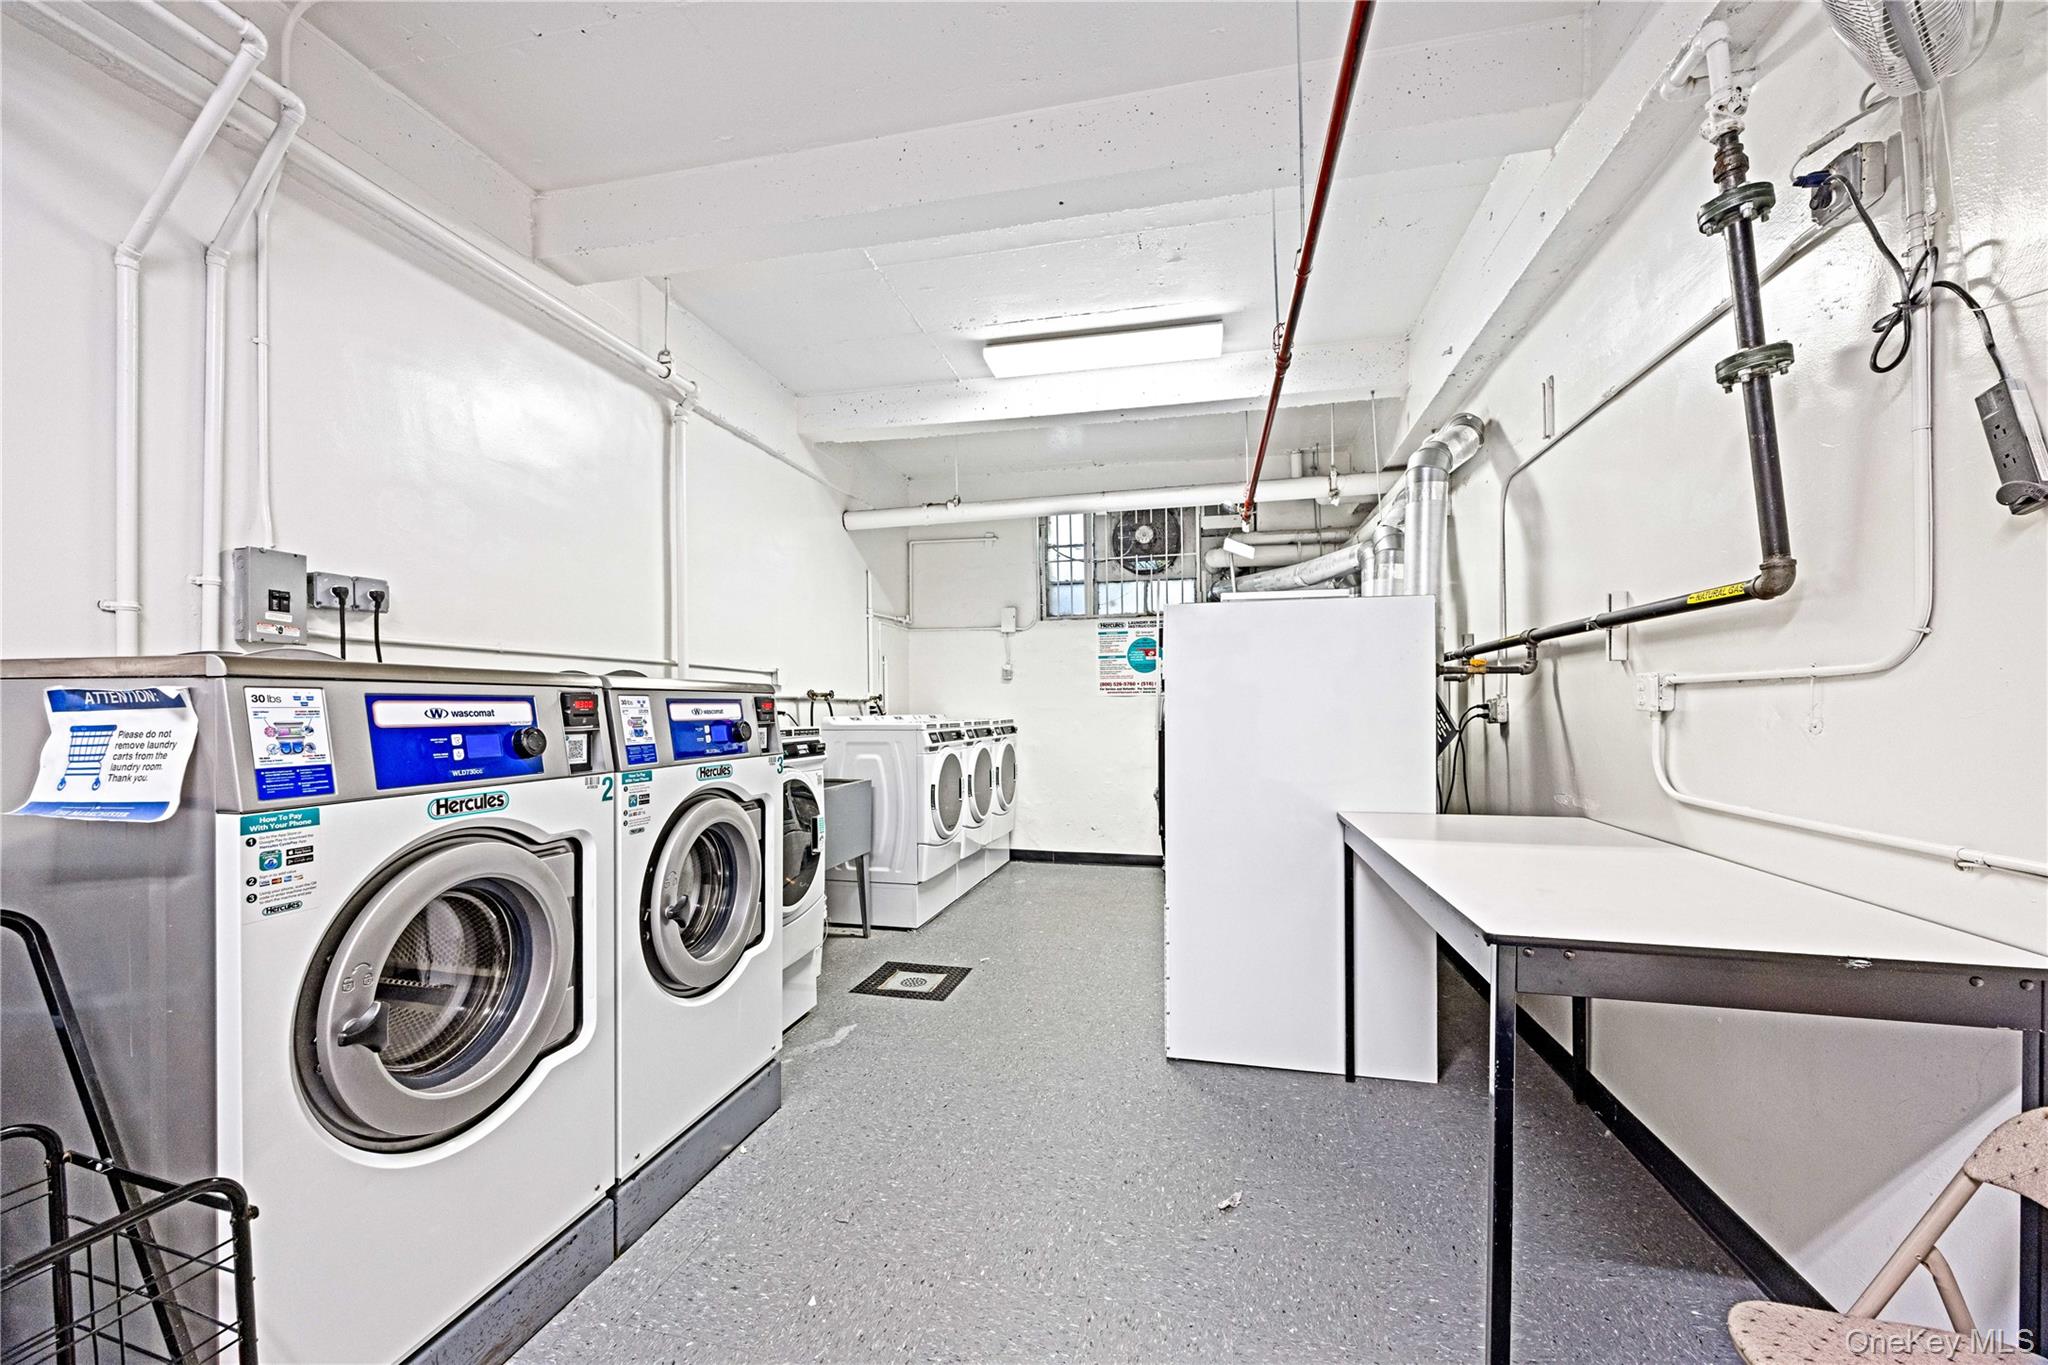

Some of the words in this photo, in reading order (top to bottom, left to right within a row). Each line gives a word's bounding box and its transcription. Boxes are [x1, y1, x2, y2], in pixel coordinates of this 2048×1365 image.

[1696, 588, 1726, 601] NATURAL
[1728, 584, 1744, 594] GAS
[84, 690, 160, 705] ATTENTION:
[251, 694, 265, 703] 30
[267, 694, 282, 703] lbs
[451, 709, 495, 718] wascomat
[118, 730, 144, 739] Please
[146, 730, 156, 738] do
[158, 730, 172, 738] not
[146, 740, 178, 751] laundry
[134, 752, 154, 760] from
[110, 763, 140, 773] laundry
[777, 756, 784, 774] 3
[700, 766, 731, 778] Hercules
[108, 773, 132, 782] Thank
[132, 775, 148, 784] you.
[602, 776, 613, 802] 2
[435, 794, 504, 816] Hercules
[259, 815, 278, 823] How
[266, 901, 300, 914] Hercules
